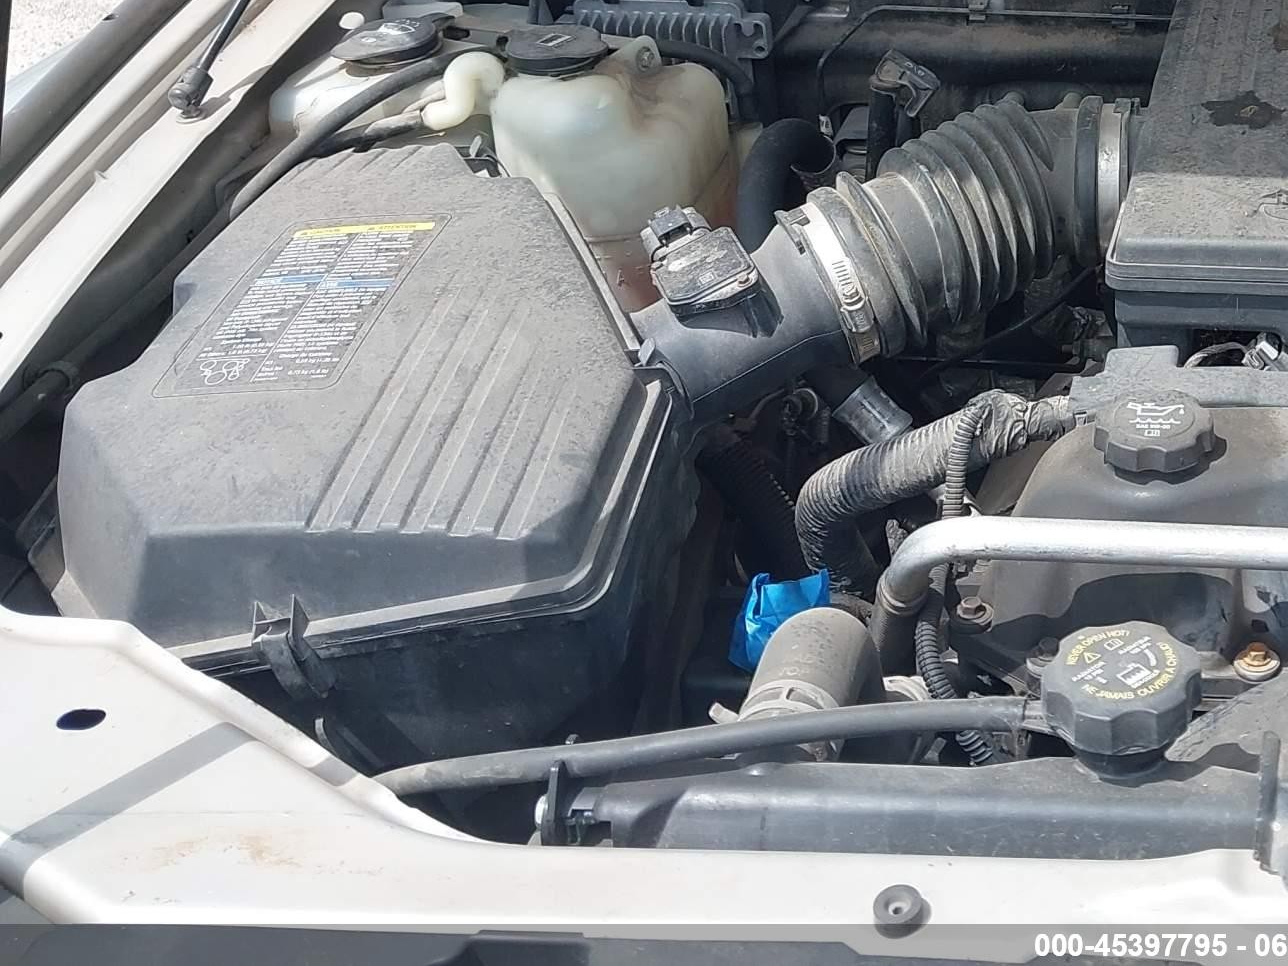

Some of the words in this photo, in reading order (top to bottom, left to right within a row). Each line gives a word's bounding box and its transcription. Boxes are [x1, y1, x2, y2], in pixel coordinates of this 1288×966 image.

[1065, 644, 1086, 666] NEVER
[1082, 633, 1107, 647] OPEN
[1081, 683, 1099, 695] NE
[1095, 690, 1135, 700] JAMAIS
[1137, 673, 1175, 696] OUVRIR
